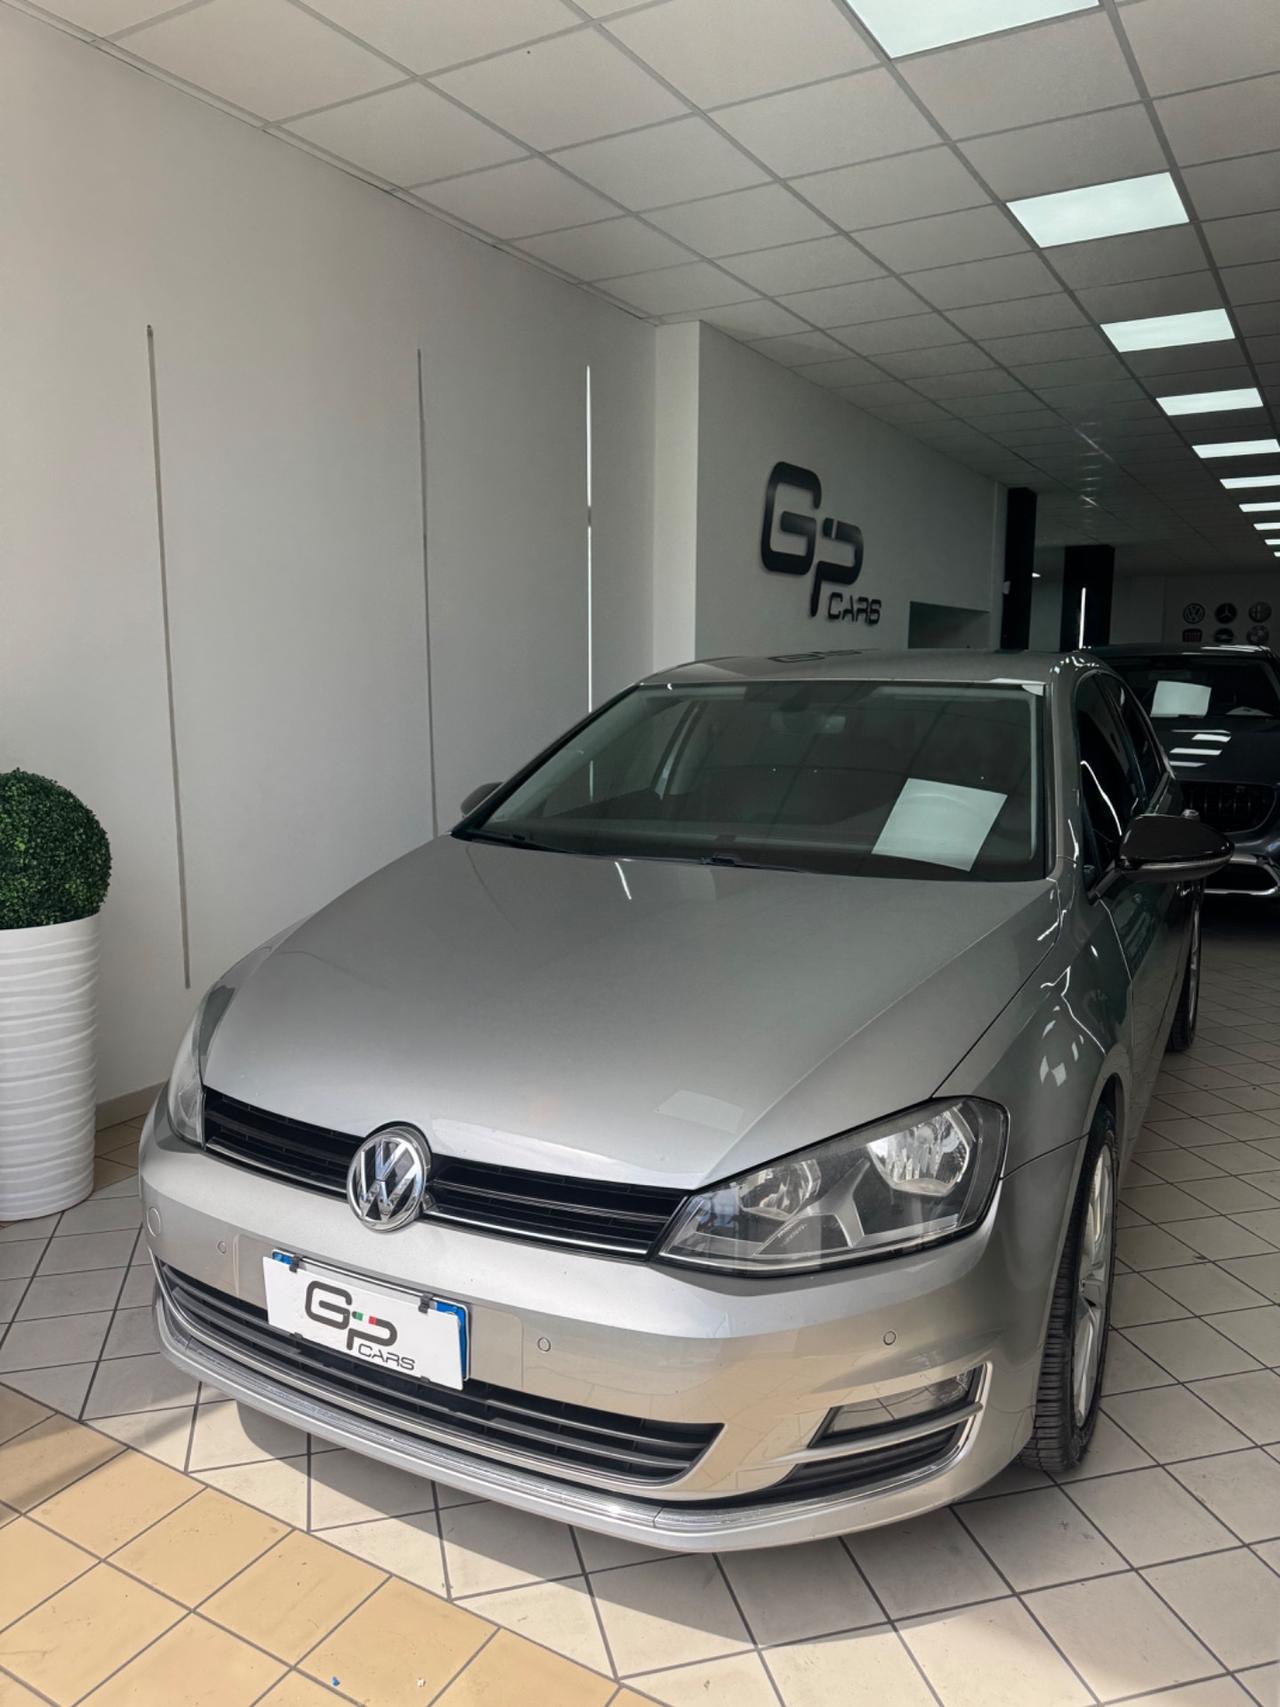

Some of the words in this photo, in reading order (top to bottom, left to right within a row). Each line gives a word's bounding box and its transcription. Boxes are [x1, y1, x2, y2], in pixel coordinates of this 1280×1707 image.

[827, 592, 882, 625] CARS
[348, 1127, 427, 1230] VW
[304, 1279, 398, 1351] GP
[358, 1343, 416, 1372] CARS
